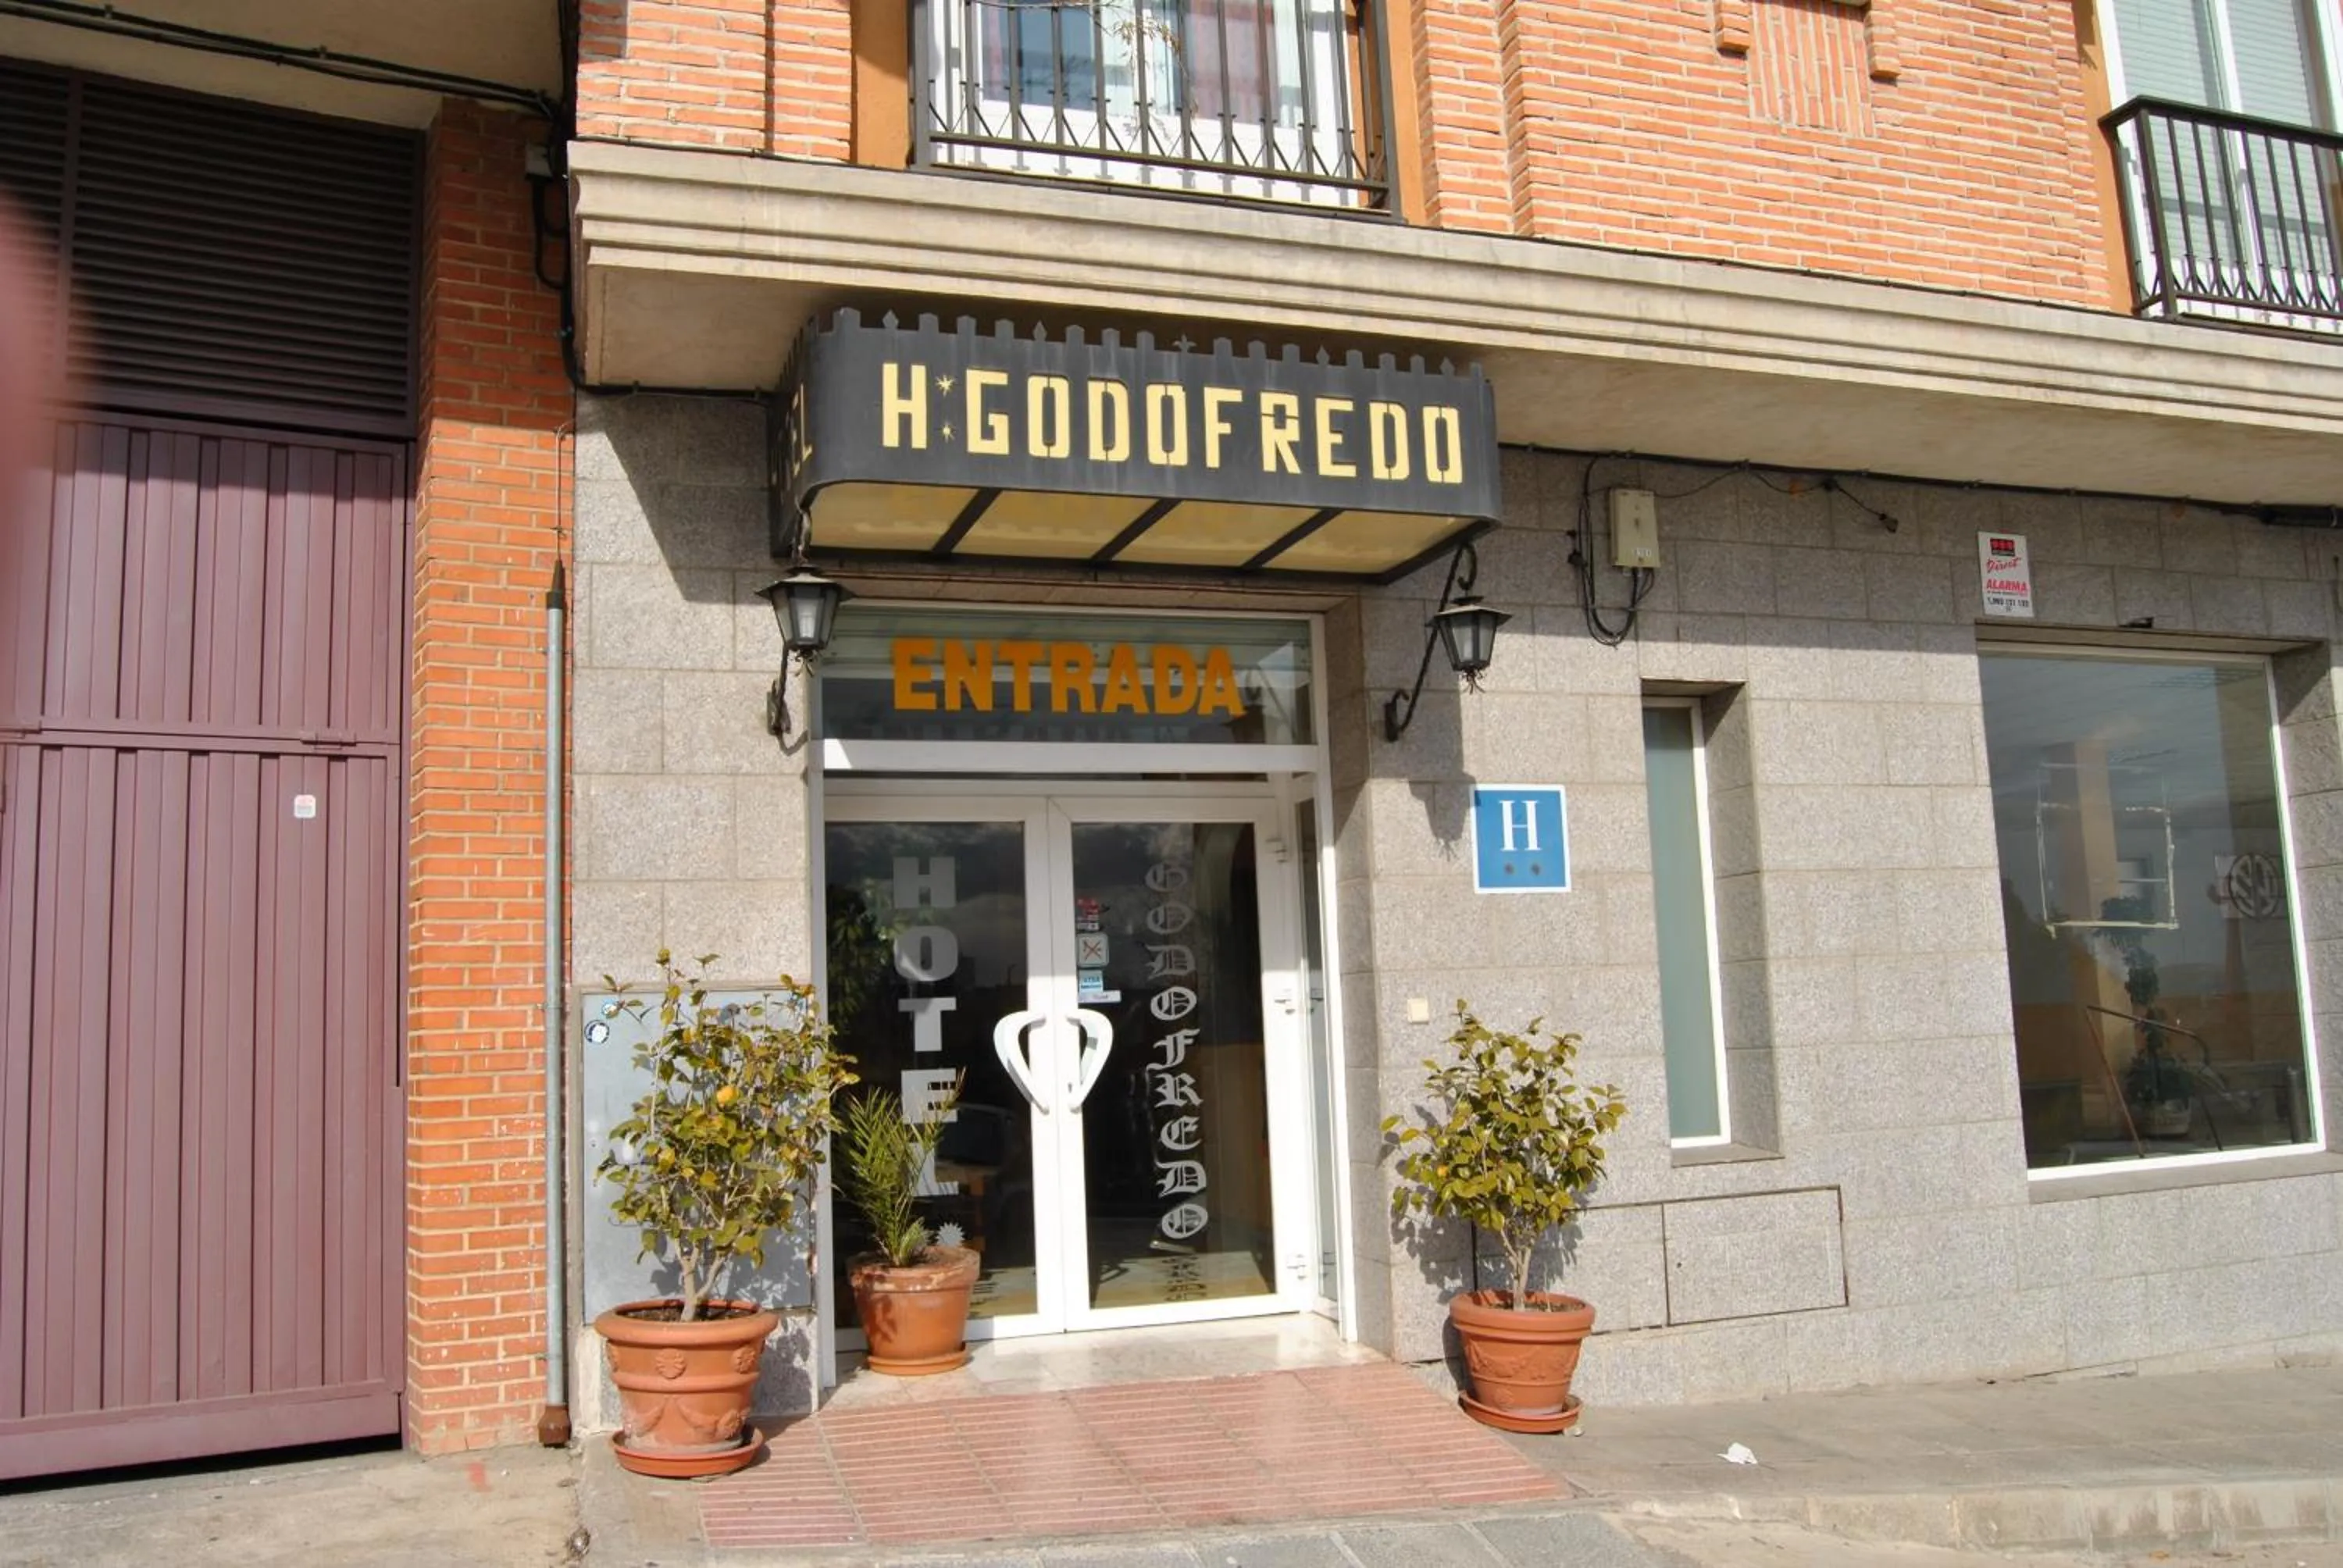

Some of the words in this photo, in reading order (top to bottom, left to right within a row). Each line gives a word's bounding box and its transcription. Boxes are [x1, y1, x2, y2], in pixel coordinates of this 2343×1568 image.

[965, 368, 1464, 484] GODOFREDO
[1986, 578, 2028, 592] ALARMA
[890, 637, 1246, 716] ENTRADA
[1498, 800, 1542, 852] H
[892, 857, 960, 1196] HOTEL
[1145, 860, 1210, 1240] GODOFREDO
